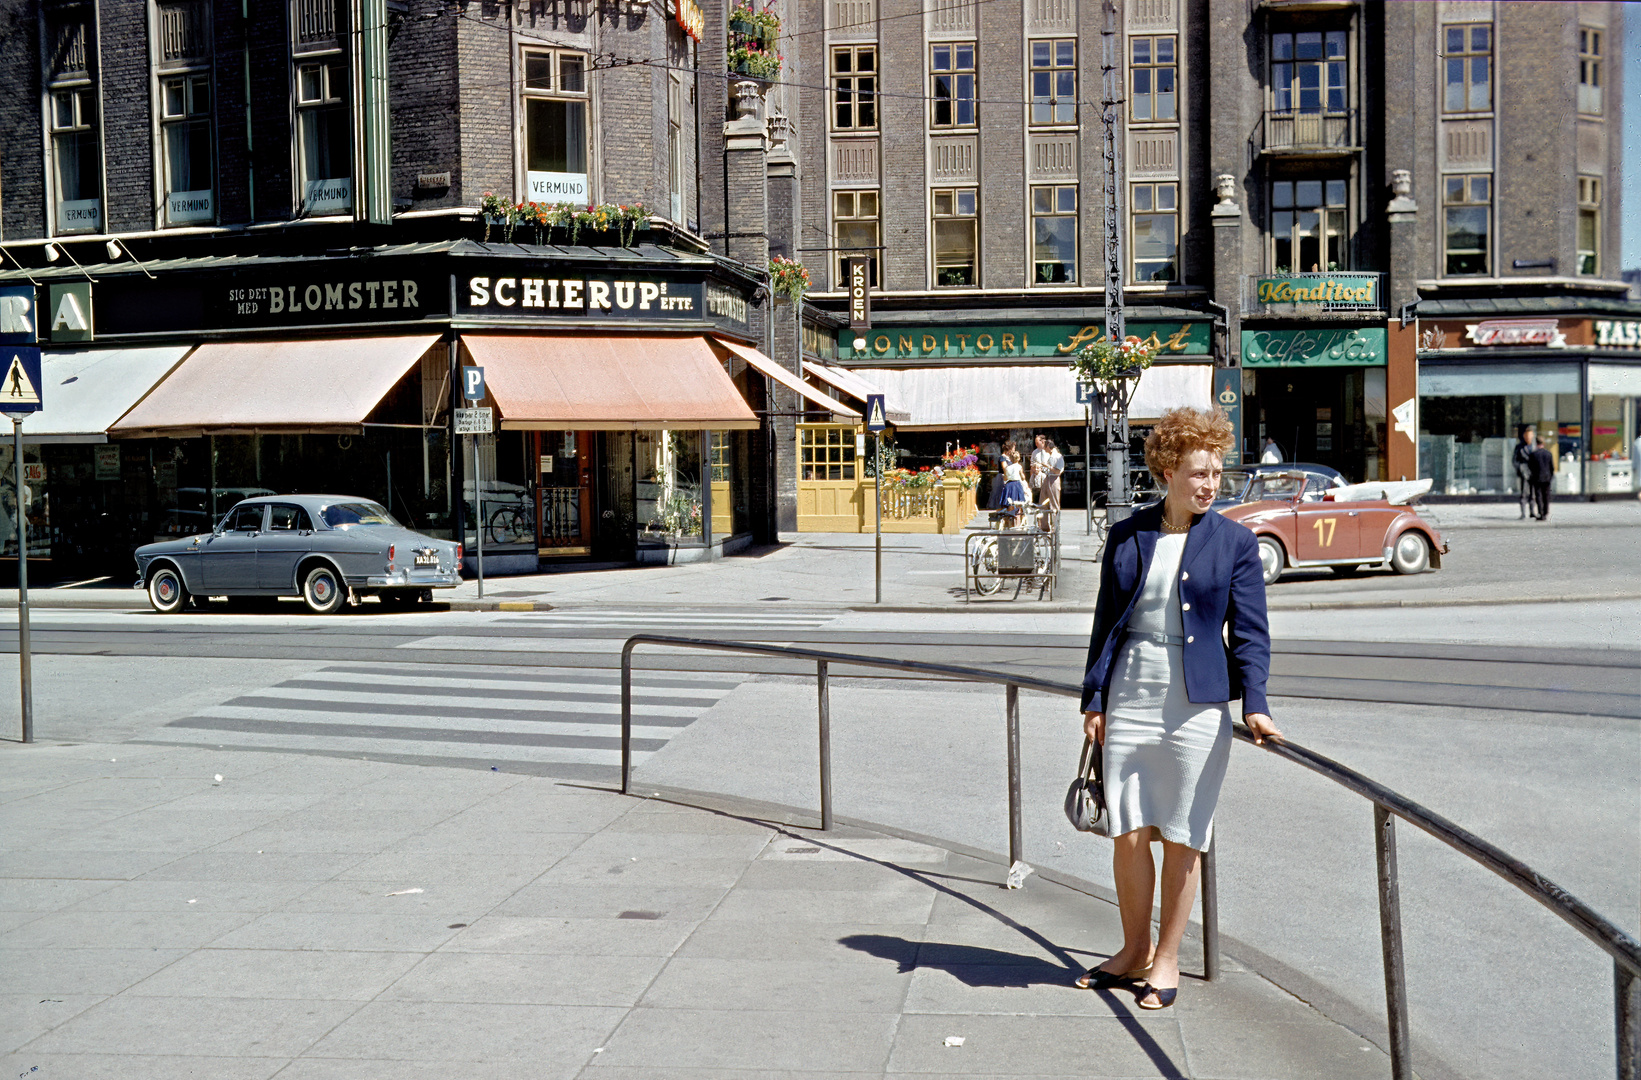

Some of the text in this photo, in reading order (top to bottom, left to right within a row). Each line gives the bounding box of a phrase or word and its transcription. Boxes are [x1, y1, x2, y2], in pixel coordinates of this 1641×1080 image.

[309, 187, 348, 201] VERMUND
[533, 180, 583, 195] VERMUND
[171, 198, 210, 213] VERMUND
[229, 288, 268, 301] SIG DET
[269, 280, 419, 314] BLOMSTER
[853, 264, 865, 321] KROEN
[1258, 280, 1373, 303] Konditori
[237, 302, 259, 315] MED
[660, 297, 694, 310] EFTF.
[1596, 320, 1641, 346] TAS
[467, 370, 482, 395] P
[1313, 518, 1337, 548] 17
